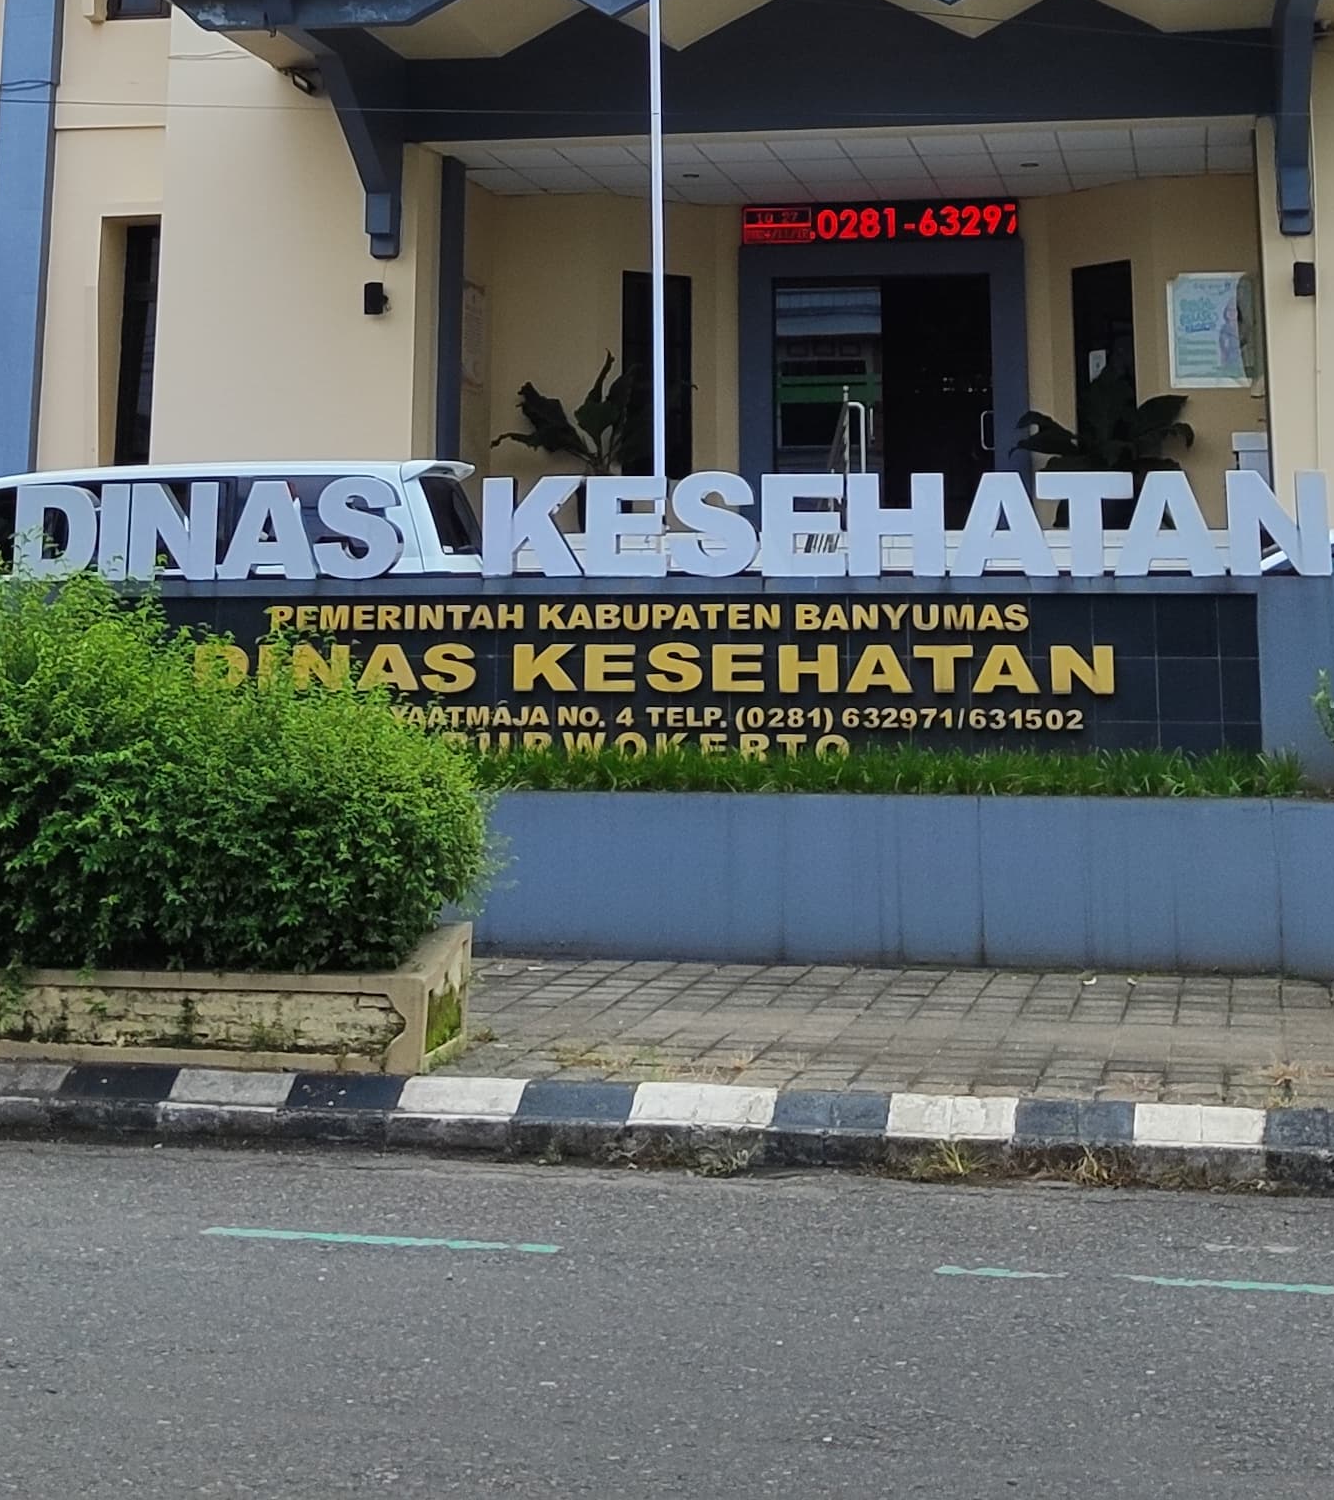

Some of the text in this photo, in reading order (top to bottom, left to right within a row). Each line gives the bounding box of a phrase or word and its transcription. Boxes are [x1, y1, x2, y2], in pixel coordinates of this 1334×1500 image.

[12, 470, 1332, 581] DINAS KESEHATAN
[270, 603, 1030, 631] PEMERINTAH KABUPATEN BANYUMAS
[514, 642, 1115, 694] KESEHATAN
[558, 705, 606, 728] NO.
[615, 706, 635, 727] 4
[645, 706, 727, 728] TELP.
[735, 706, 834, 732] (0281)
[842, 707, 1085, 731] 632971/631502
